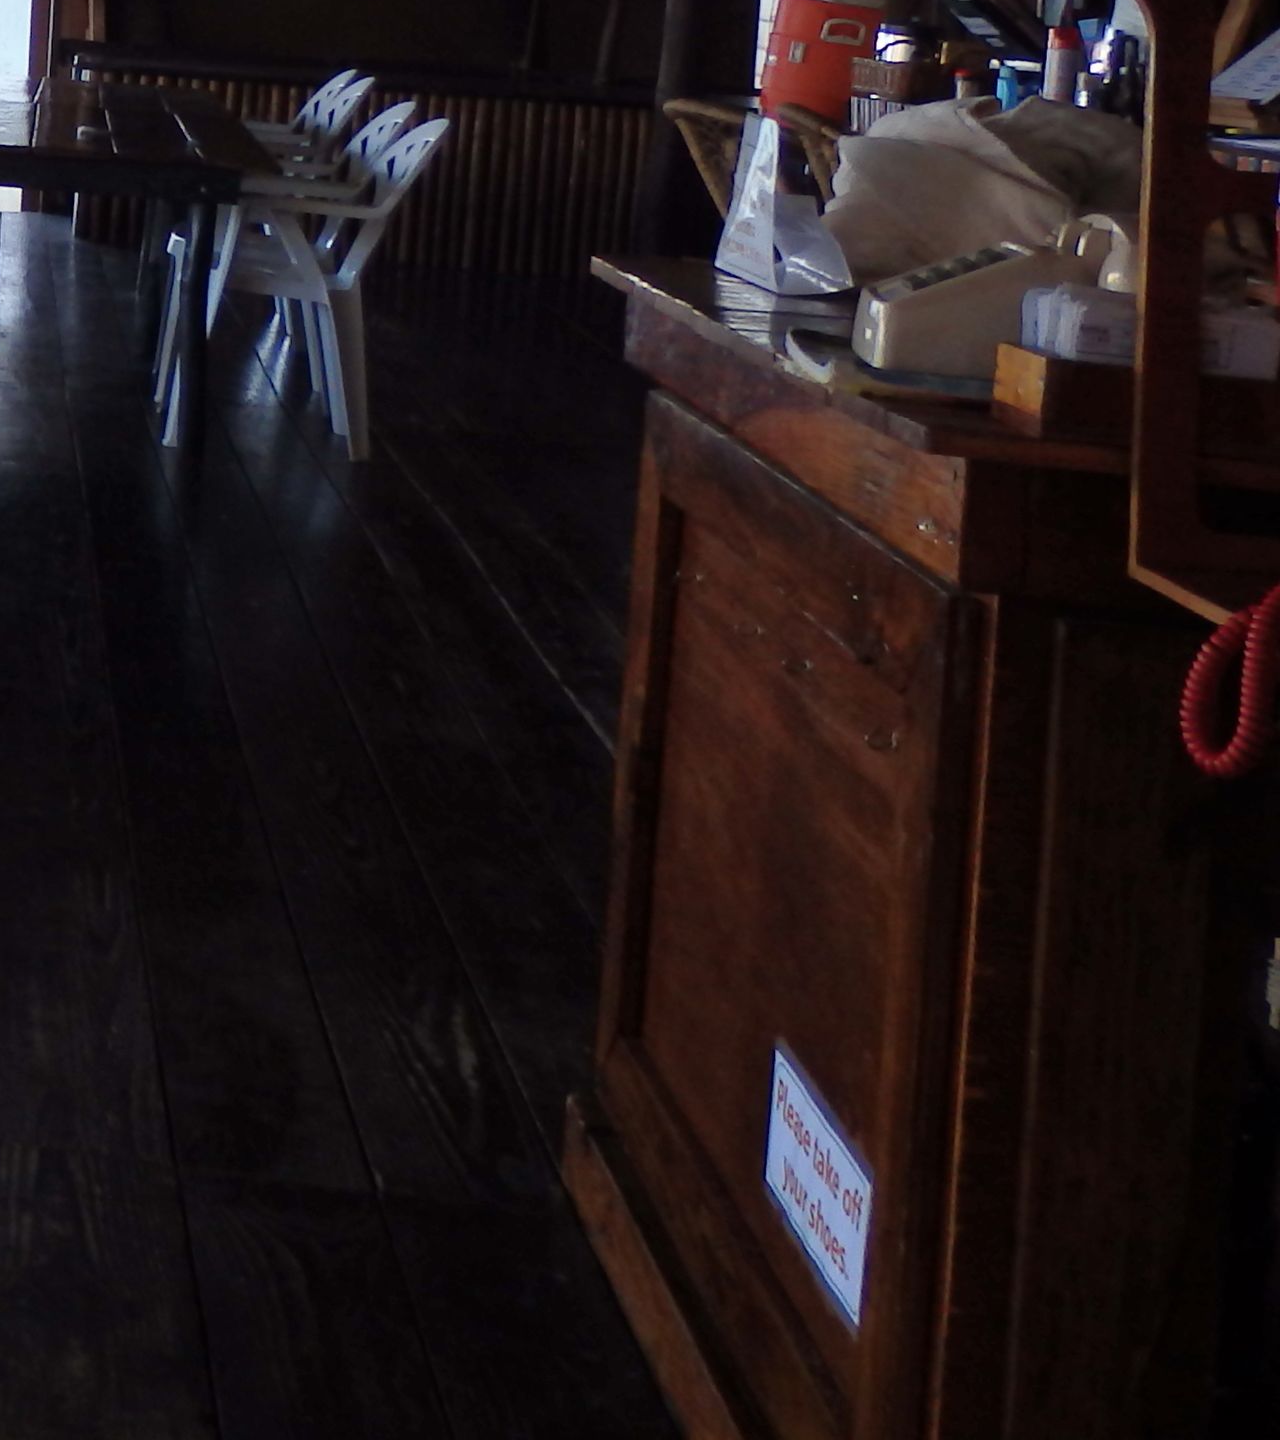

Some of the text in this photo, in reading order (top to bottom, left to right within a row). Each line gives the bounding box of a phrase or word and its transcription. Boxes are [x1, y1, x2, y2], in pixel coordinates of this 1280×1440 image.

[776, 1078, 864, 1232] Please take off
[781, 1157, 850, 1280] your shoes.
